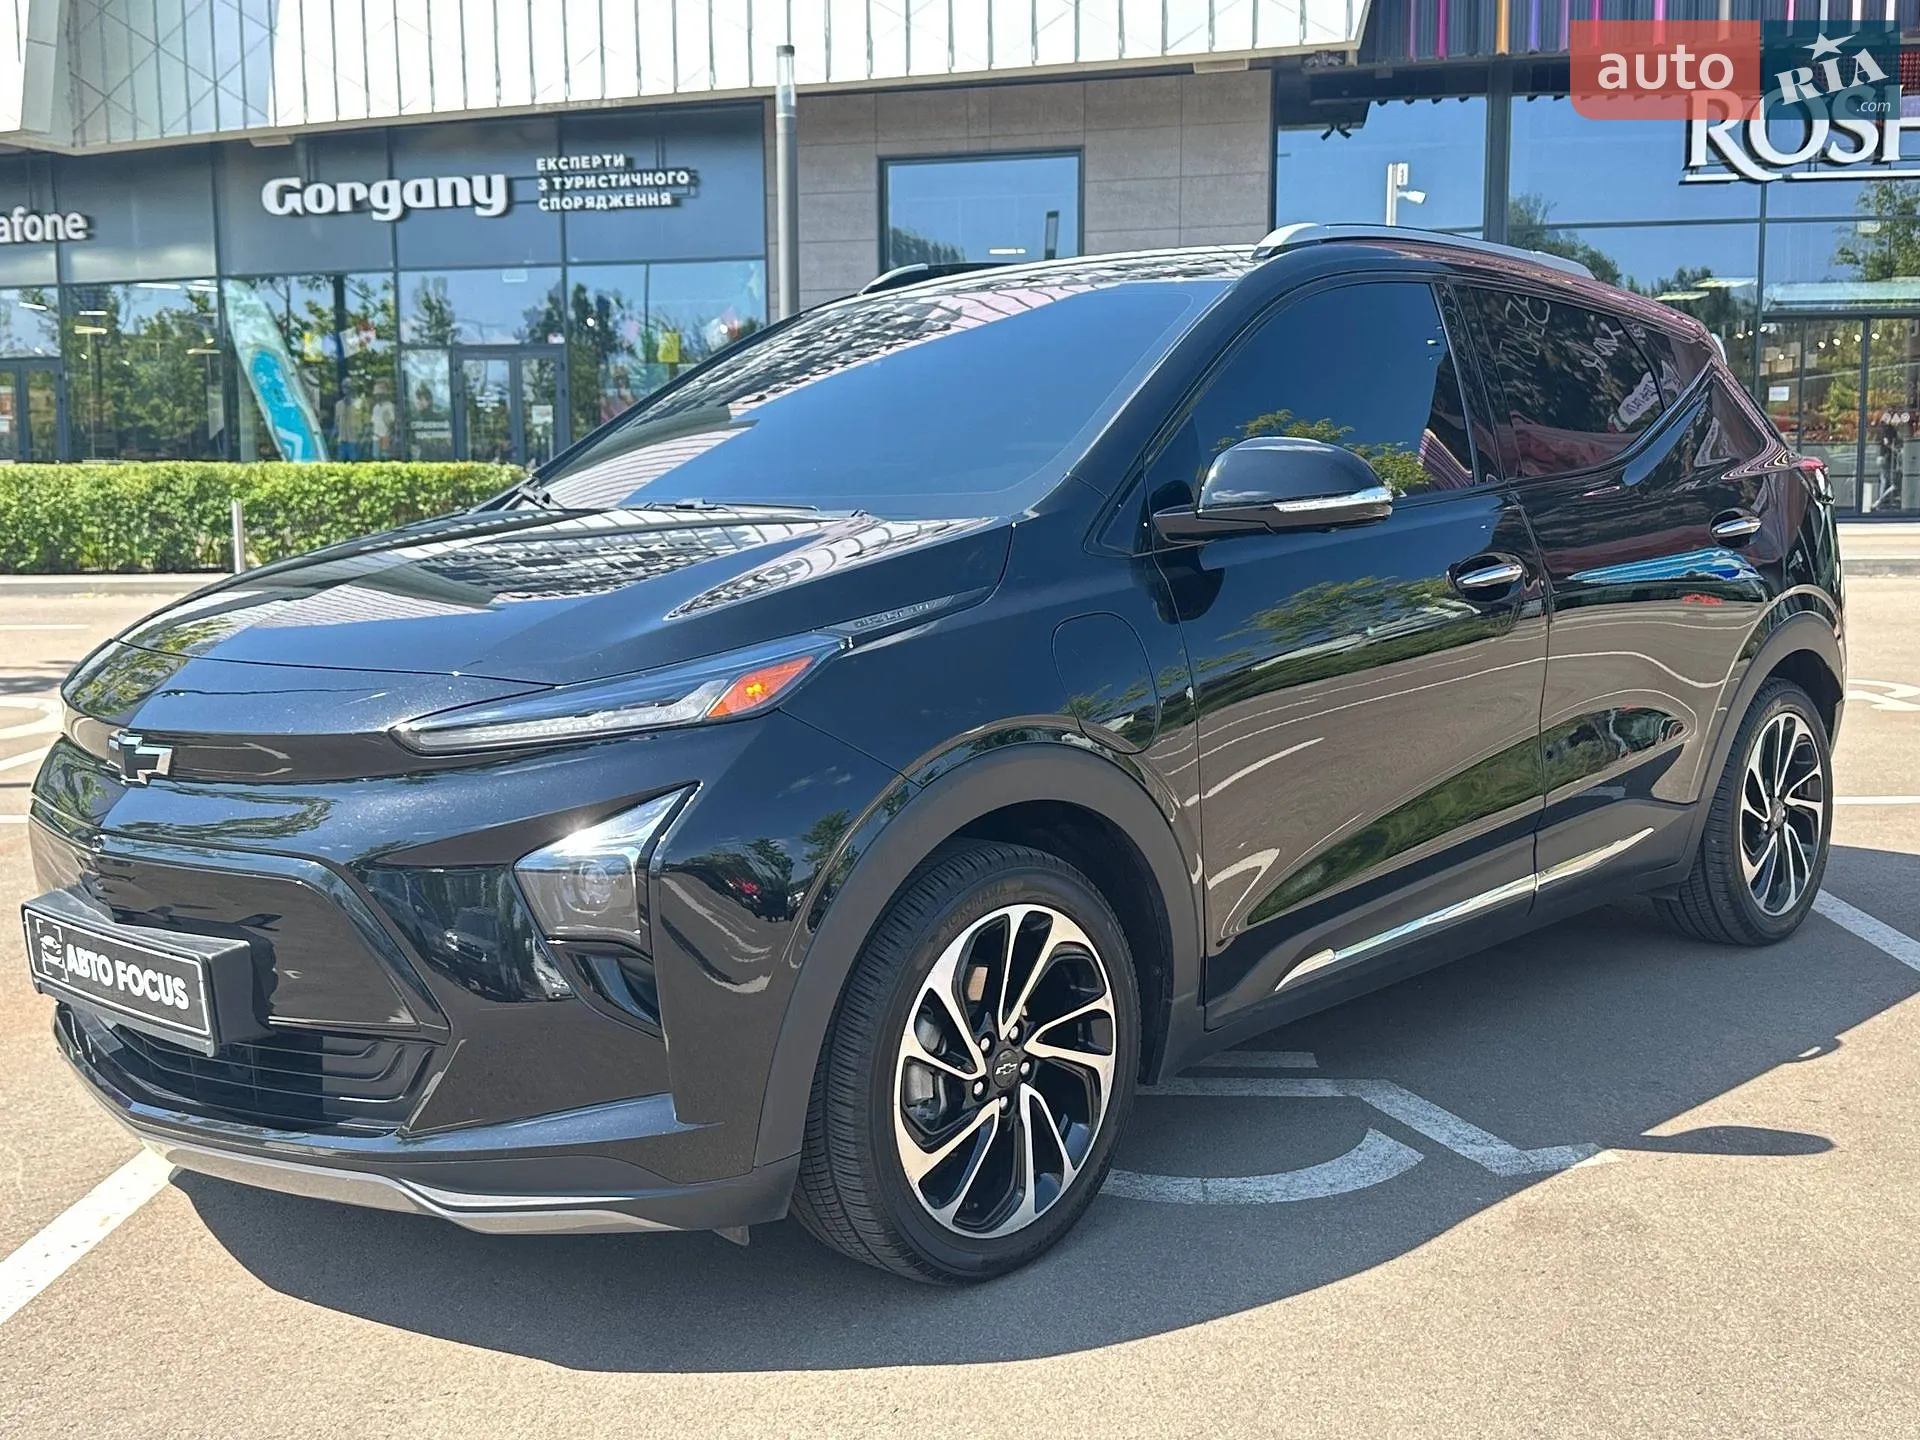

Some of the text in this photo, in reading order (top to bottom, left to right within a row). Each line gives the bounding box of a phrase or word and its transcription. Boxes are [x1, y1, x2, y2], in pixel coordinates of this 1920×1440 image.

[536, 153, 625, 171] ЕКСПЕРТИ
[552, 170, 690, 190] ТУРИСТИЧНОГО
[261, 172, 508, 222] Gorgany
[538, 192, 672, 210] СПОРЯДЖЕННЯ
[115, 959, 190, 1010] FOCUS
